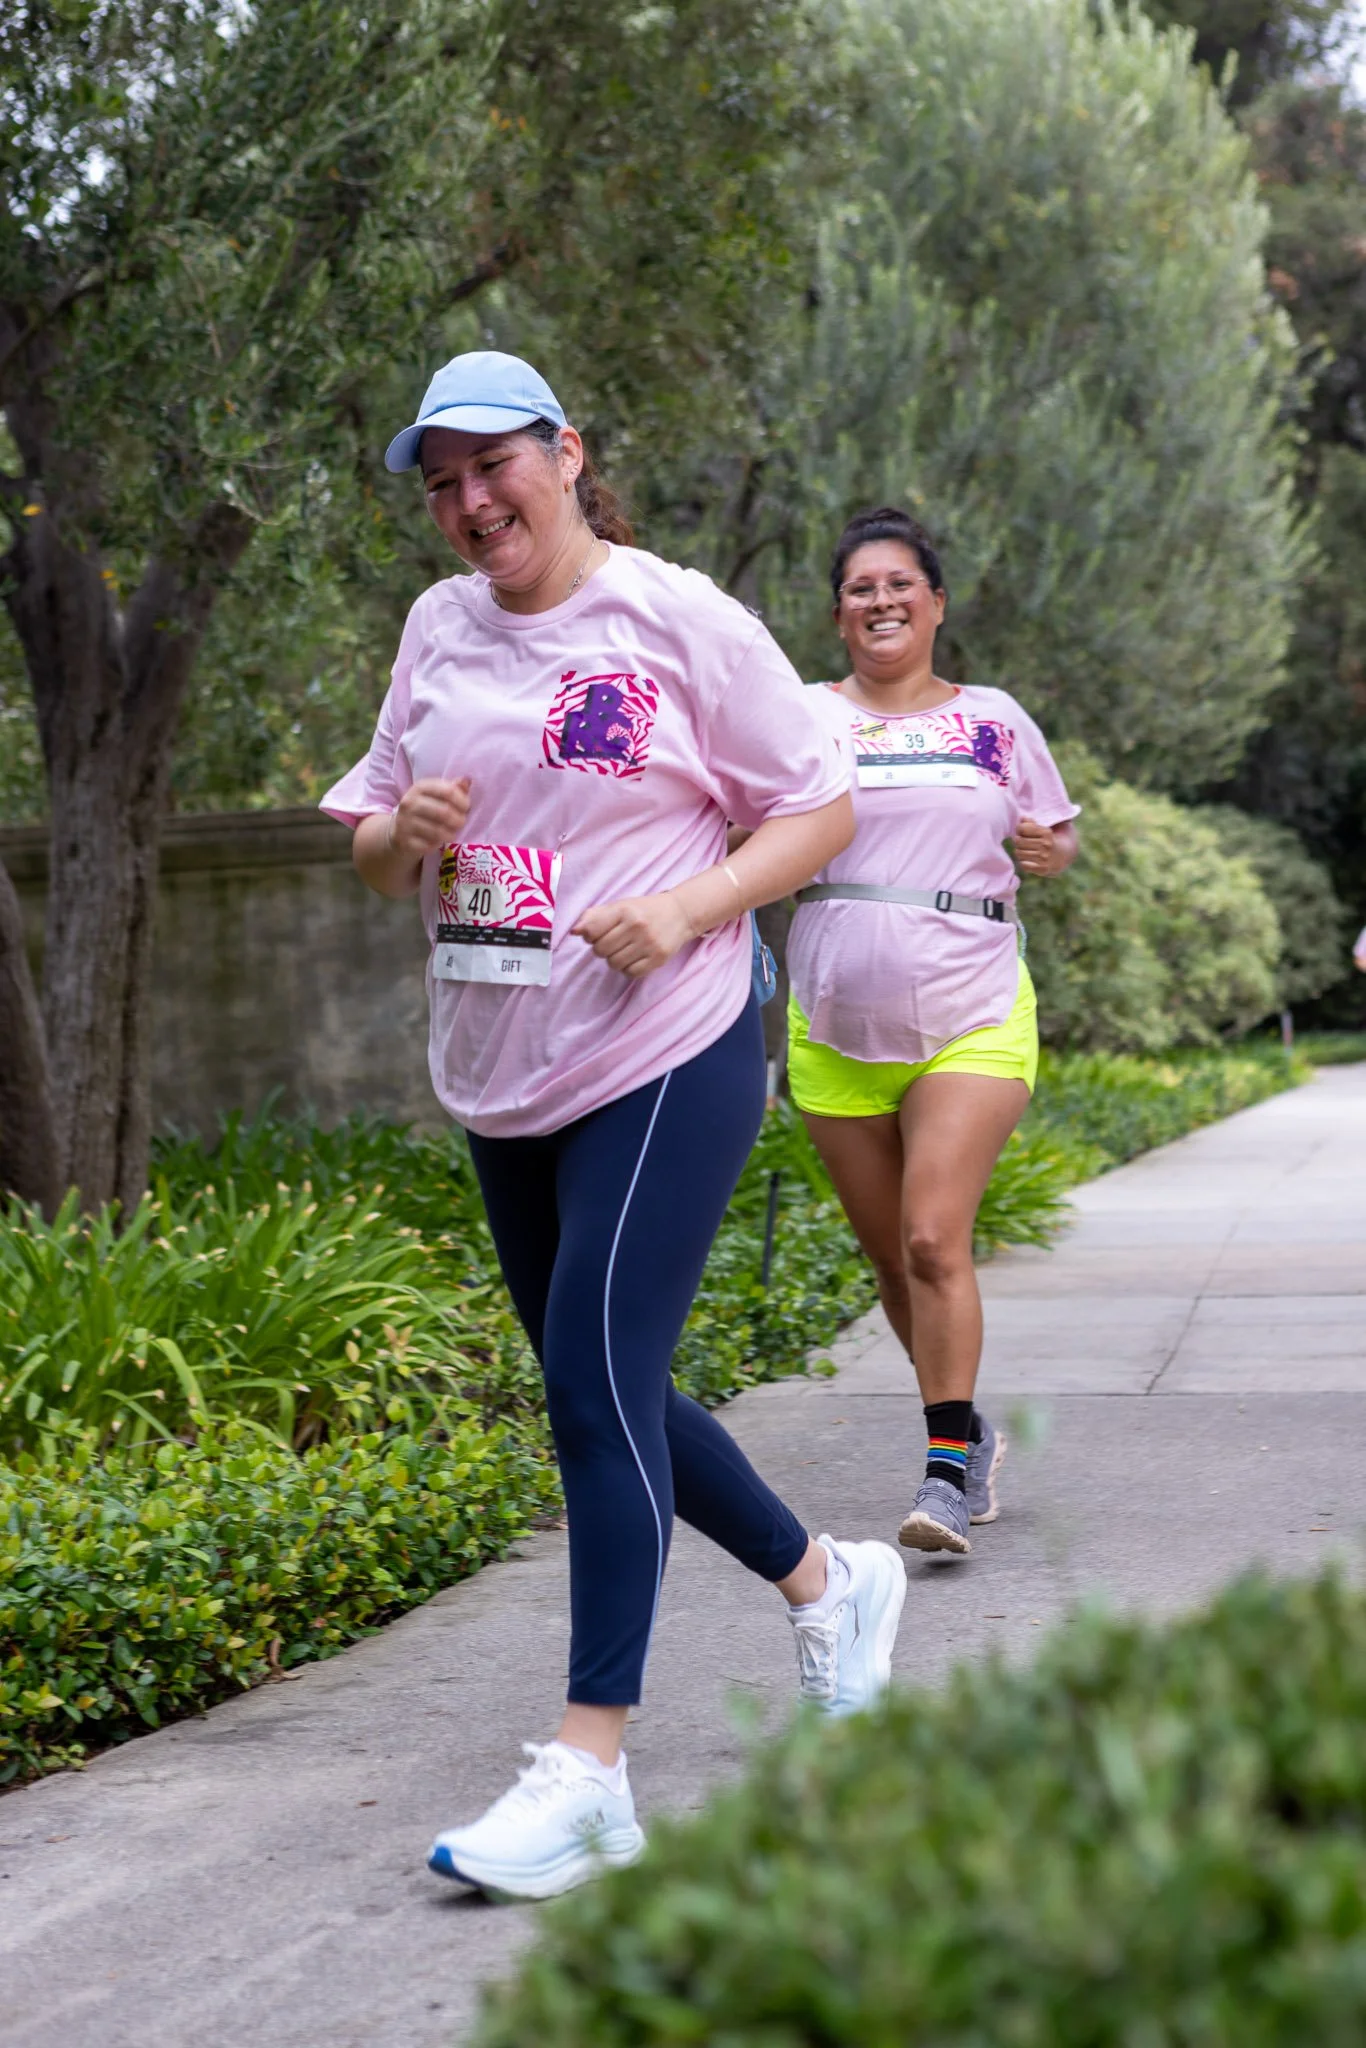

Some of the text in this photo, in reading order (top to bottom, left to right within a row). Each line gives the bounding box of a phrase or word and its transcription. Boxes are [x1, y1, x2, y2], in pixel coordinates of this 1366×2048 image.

[904, 733, 925, 749] 39
[467, 888, 491, 917] 40
[500, 959, 522, 973] GIFT
